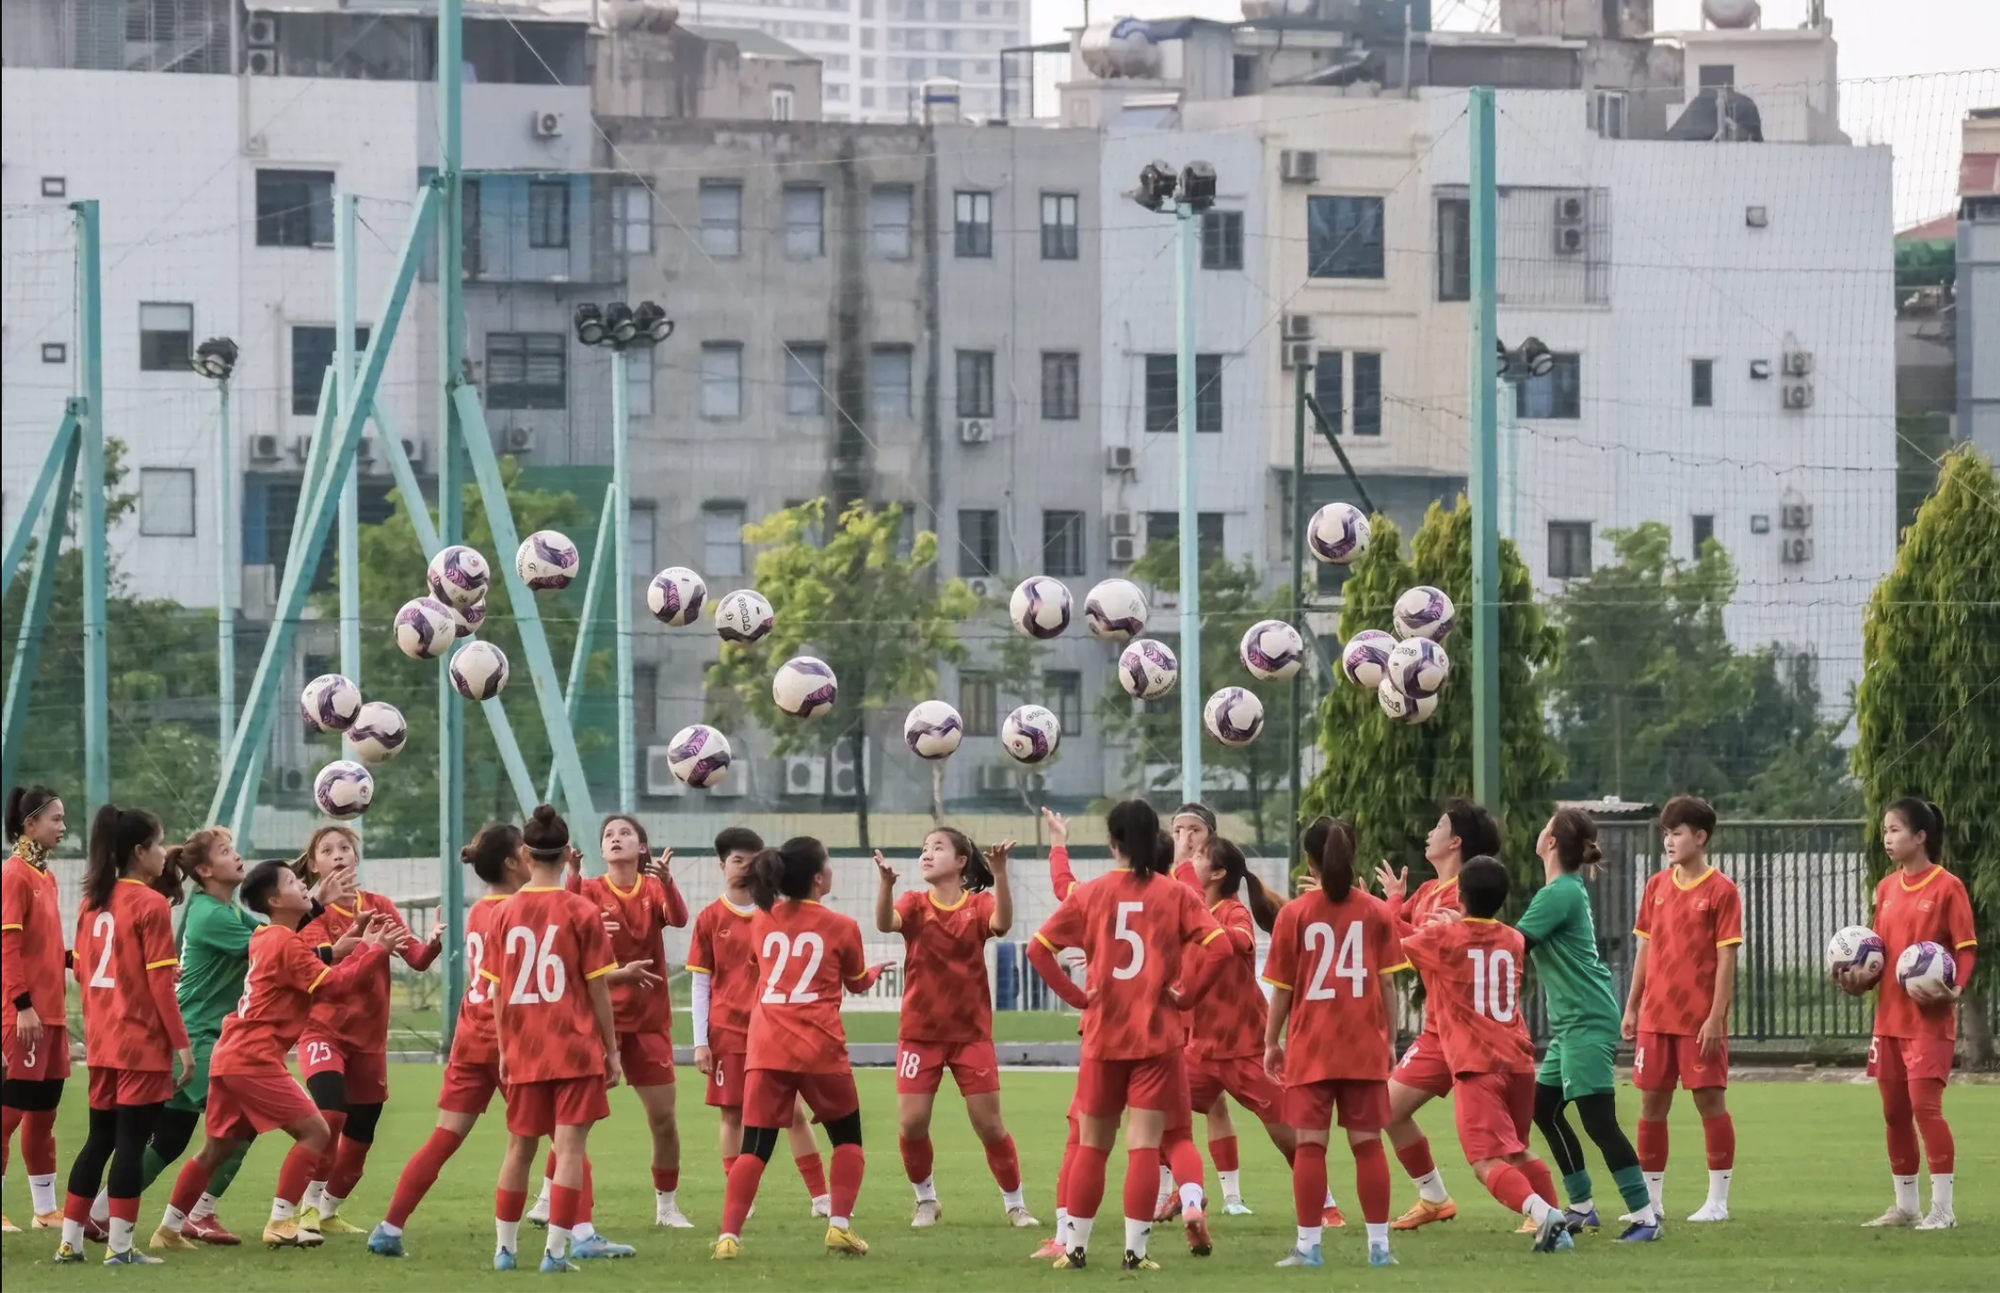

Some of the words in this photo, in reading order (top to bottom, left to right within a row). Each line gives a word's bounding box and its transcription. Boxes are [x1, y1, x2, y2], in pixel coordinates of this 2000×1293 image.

[90, 912, 115, 988] 2
[506, 924, 566, 1005] 26
[761, 931, 824, 1004] 22
[1112, 902, 1144, 980] 5
[1304, 920, 1368, 1000] 24
[1468, 949, 1515, 1022] 10
[23, 1040, 36, 1068] 3
[307, 1041, 332, 1067] 25
[715, 1060, 724, 1087] 6
[900, 1050, 921, 1079] 18
